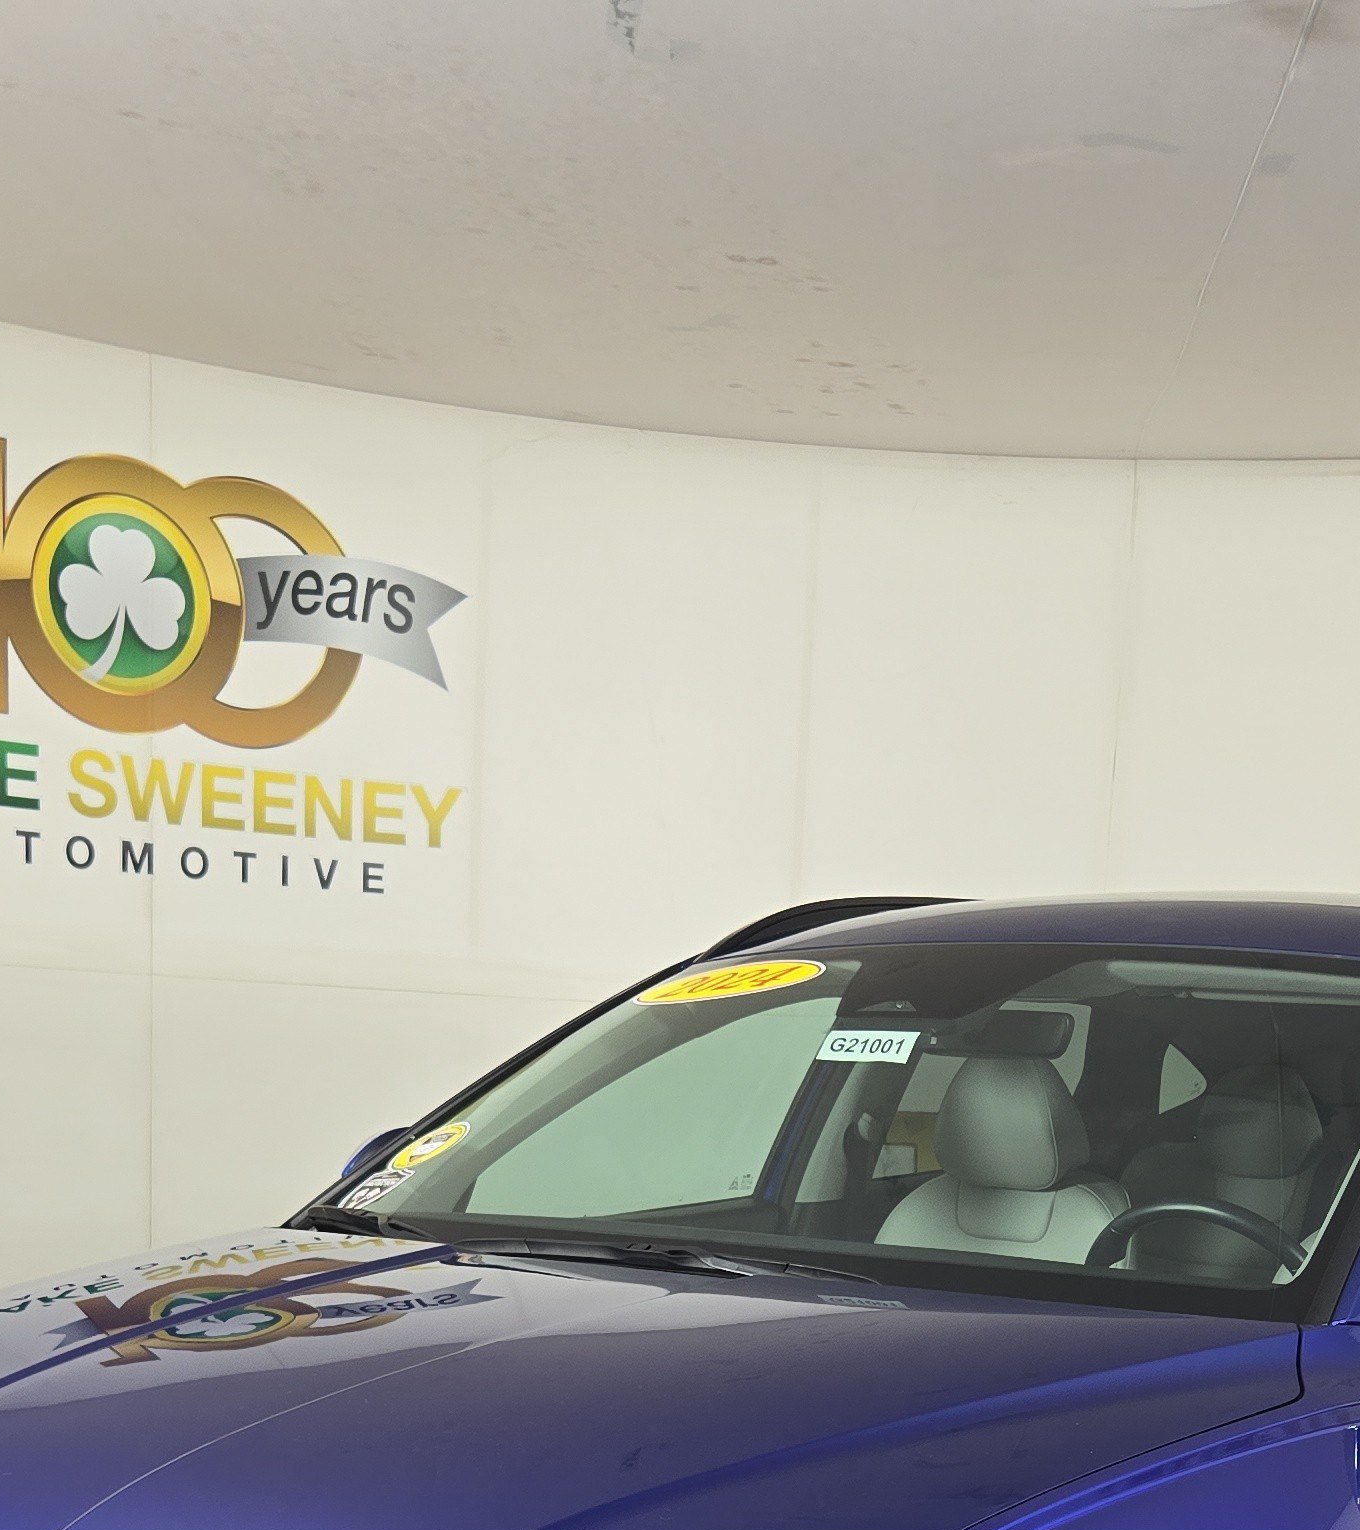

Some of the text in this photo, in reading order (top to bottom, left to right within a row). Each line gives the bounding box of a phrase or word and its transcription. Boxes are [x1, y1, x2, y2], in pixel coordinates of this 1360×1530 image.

[256, 567, 416, 635] years
[67, 748, 464, 849] SWEENEY
[655, 965, 804, 1000] 2024
[829, 1037, 906, 1055] G21001
